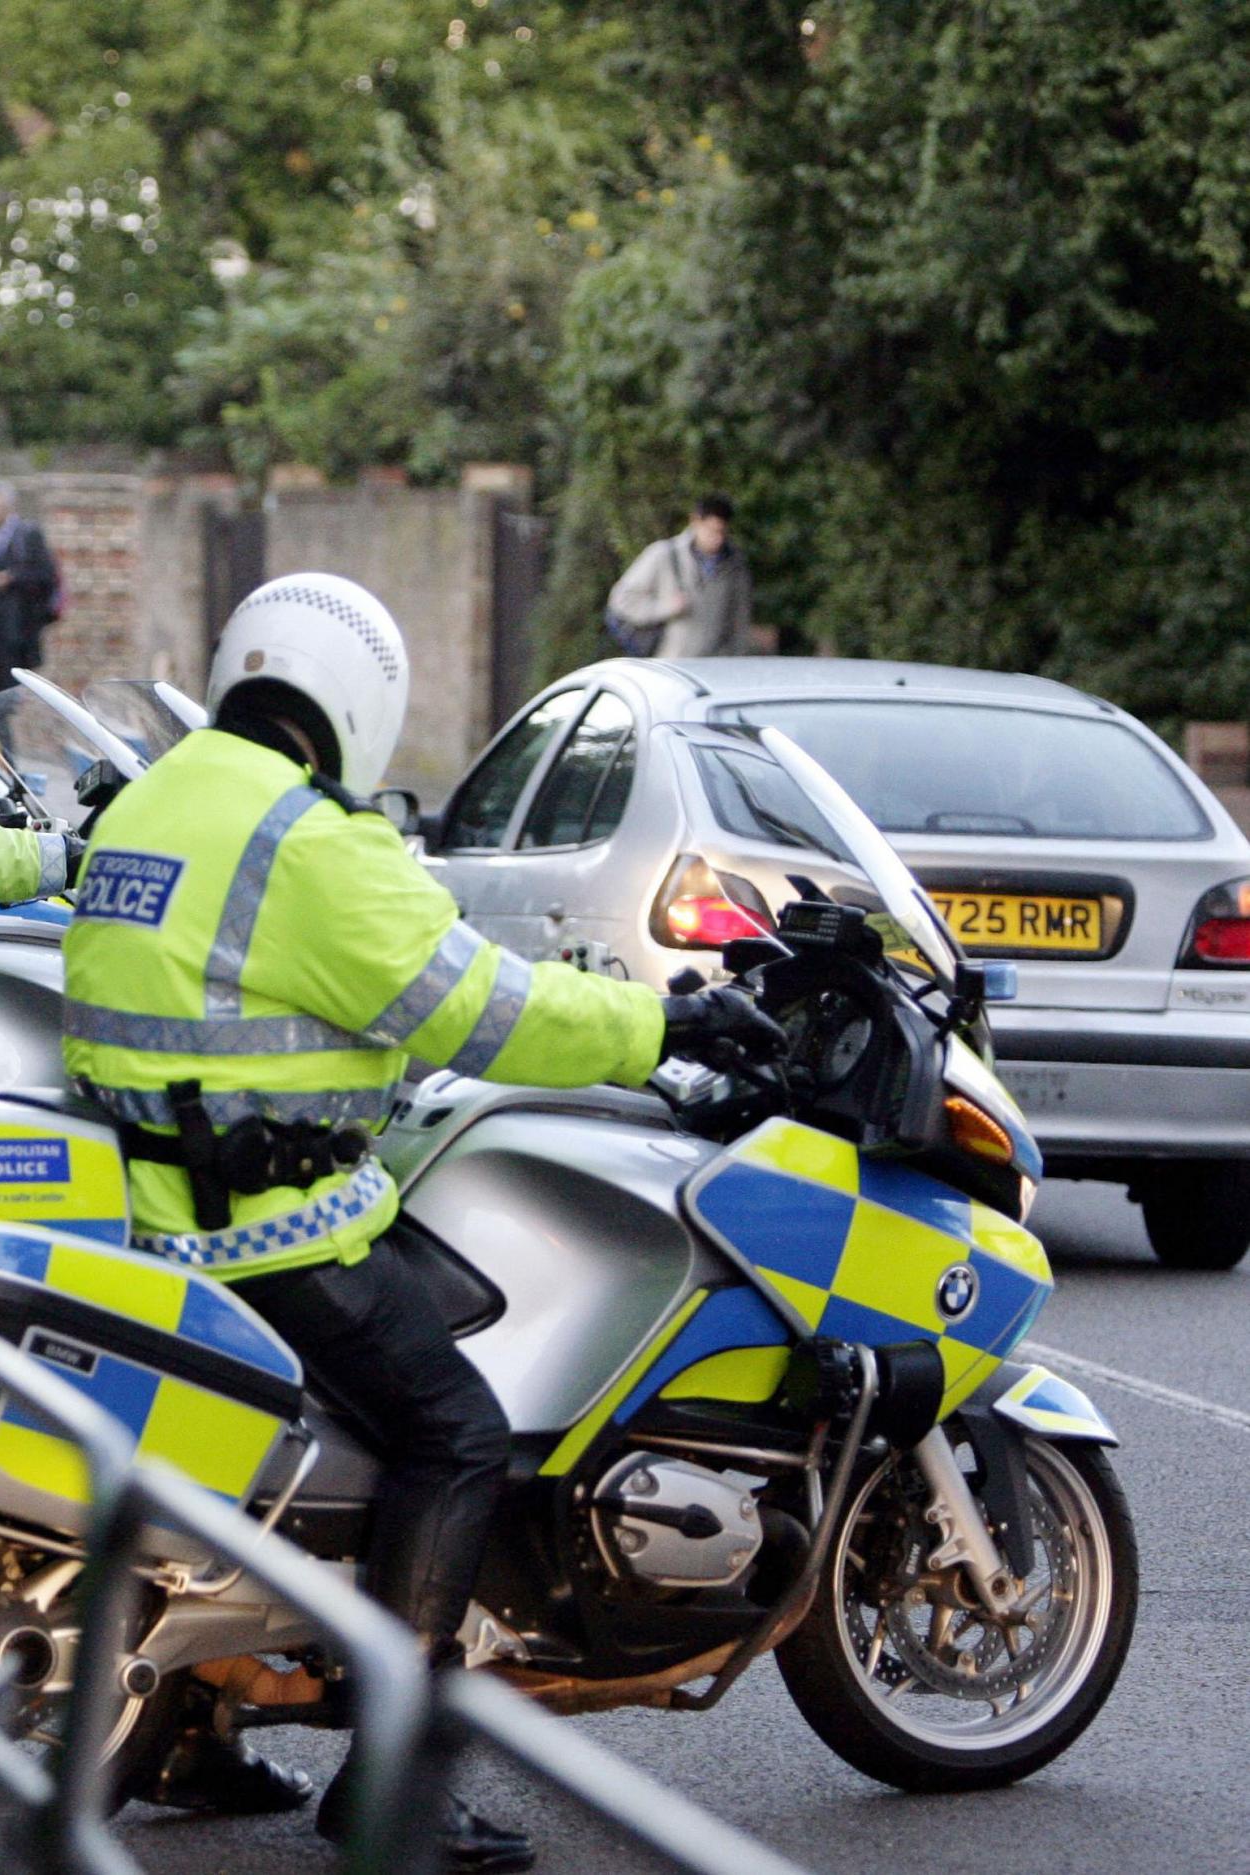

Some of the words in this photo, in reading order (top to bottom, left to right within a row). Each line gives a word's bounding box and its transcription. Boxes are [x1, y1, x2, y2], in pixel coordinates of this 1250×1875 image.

[90, 855, 174, 881] ETROPOLITAN
[80, 876, 164, 919] POLICE
[933, 899, 1006, 934] 725
[1019, 903, 1090, 939] RMR
